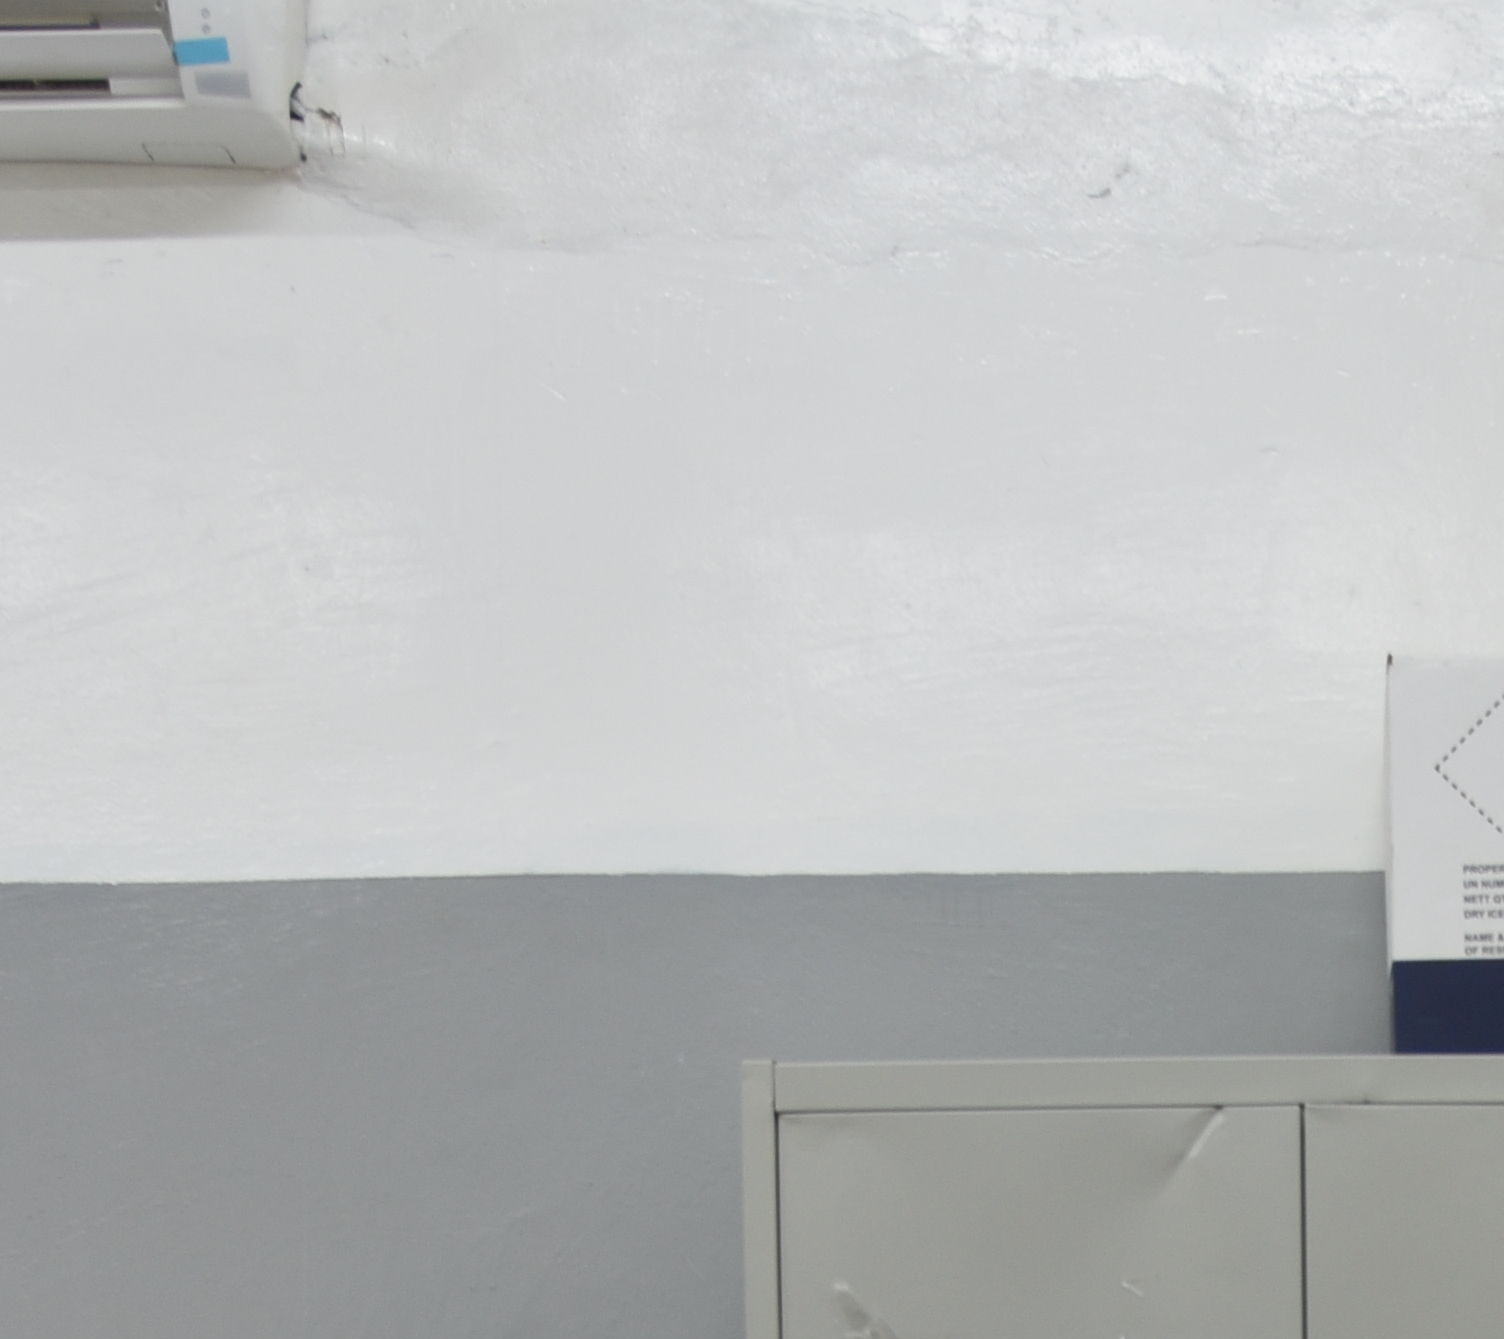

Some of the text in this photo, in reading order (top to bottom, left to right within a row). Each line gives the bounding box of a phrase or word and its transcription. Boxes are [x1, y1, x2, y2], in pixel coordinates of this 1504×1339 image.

[1463, 880, 1478, 889] UN
[1463, 895, 1490, 905] NETT
[1464, 910, 1485, 920] DRY
[1488, 909, 1504, 919] ICE
[1464, 933, 1494, 943] NAME
